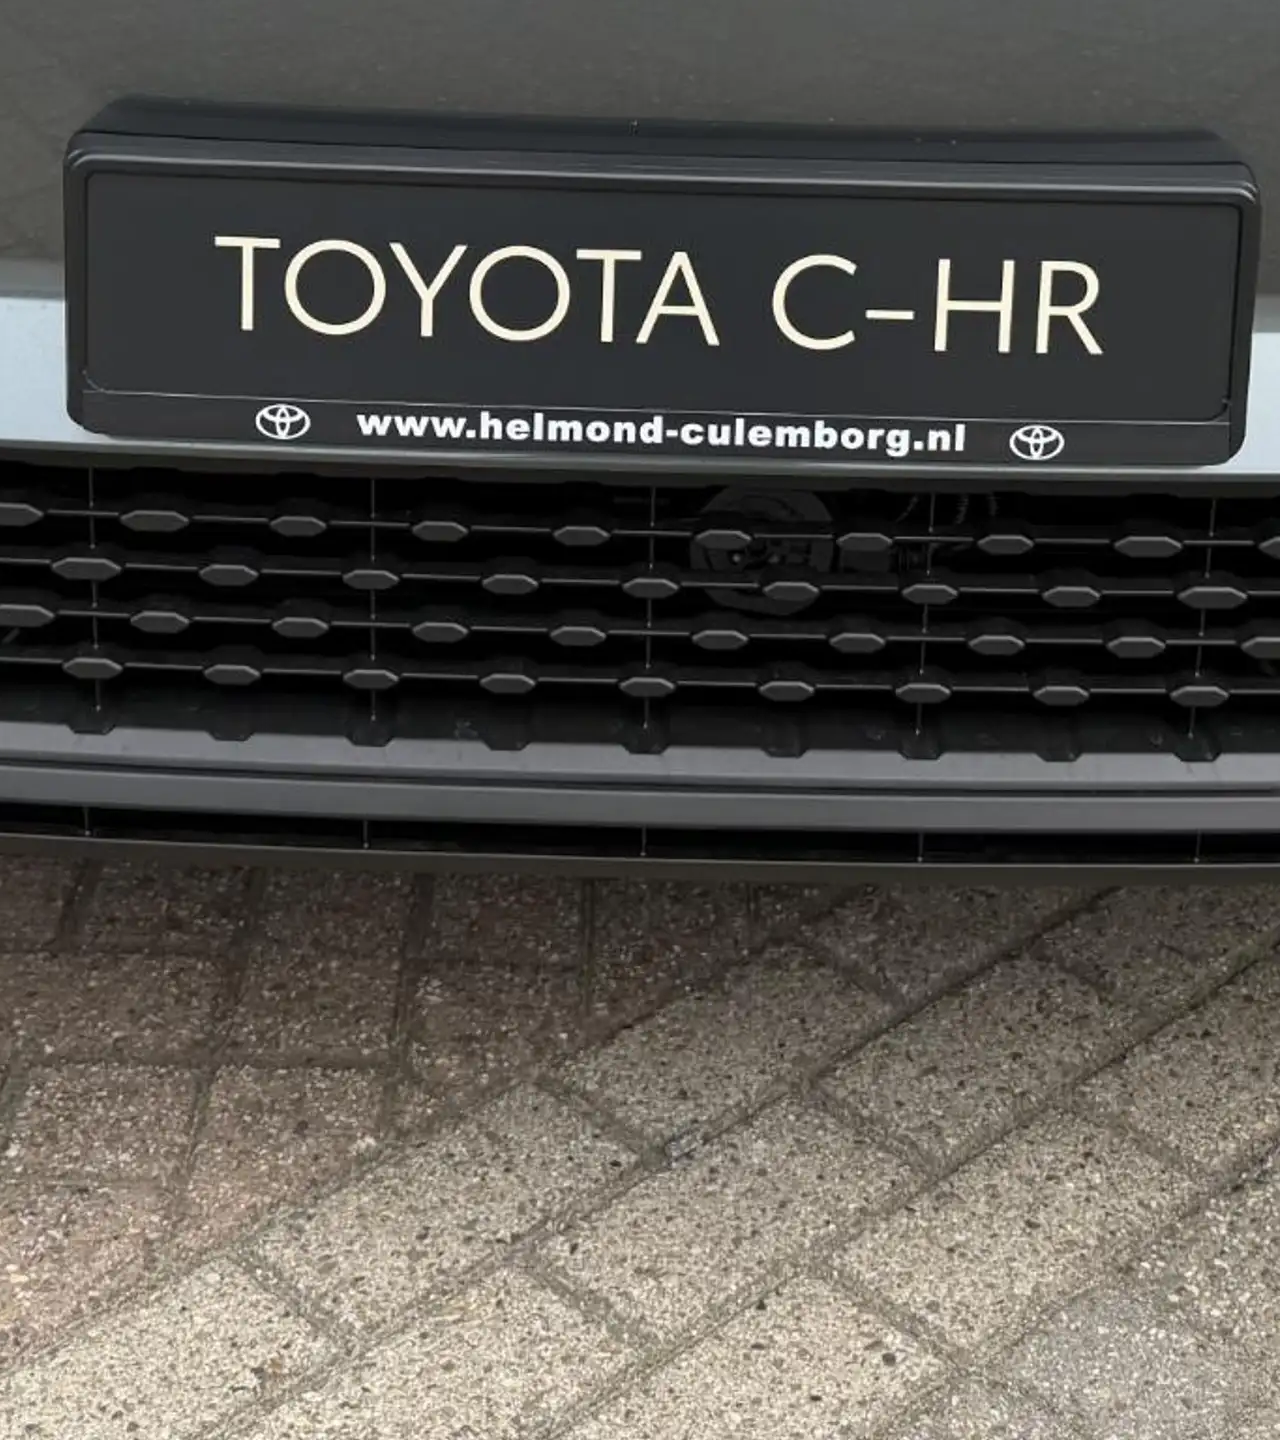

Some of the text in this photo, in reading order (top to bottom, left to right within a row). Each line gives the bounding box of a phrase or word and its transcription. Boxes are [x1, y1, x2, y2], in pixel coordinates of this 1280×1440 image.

[215, 237, 1102, 354] TOYOTA C-HR
[357, 412, 965, 456] www.helmond-culemborg.nl
